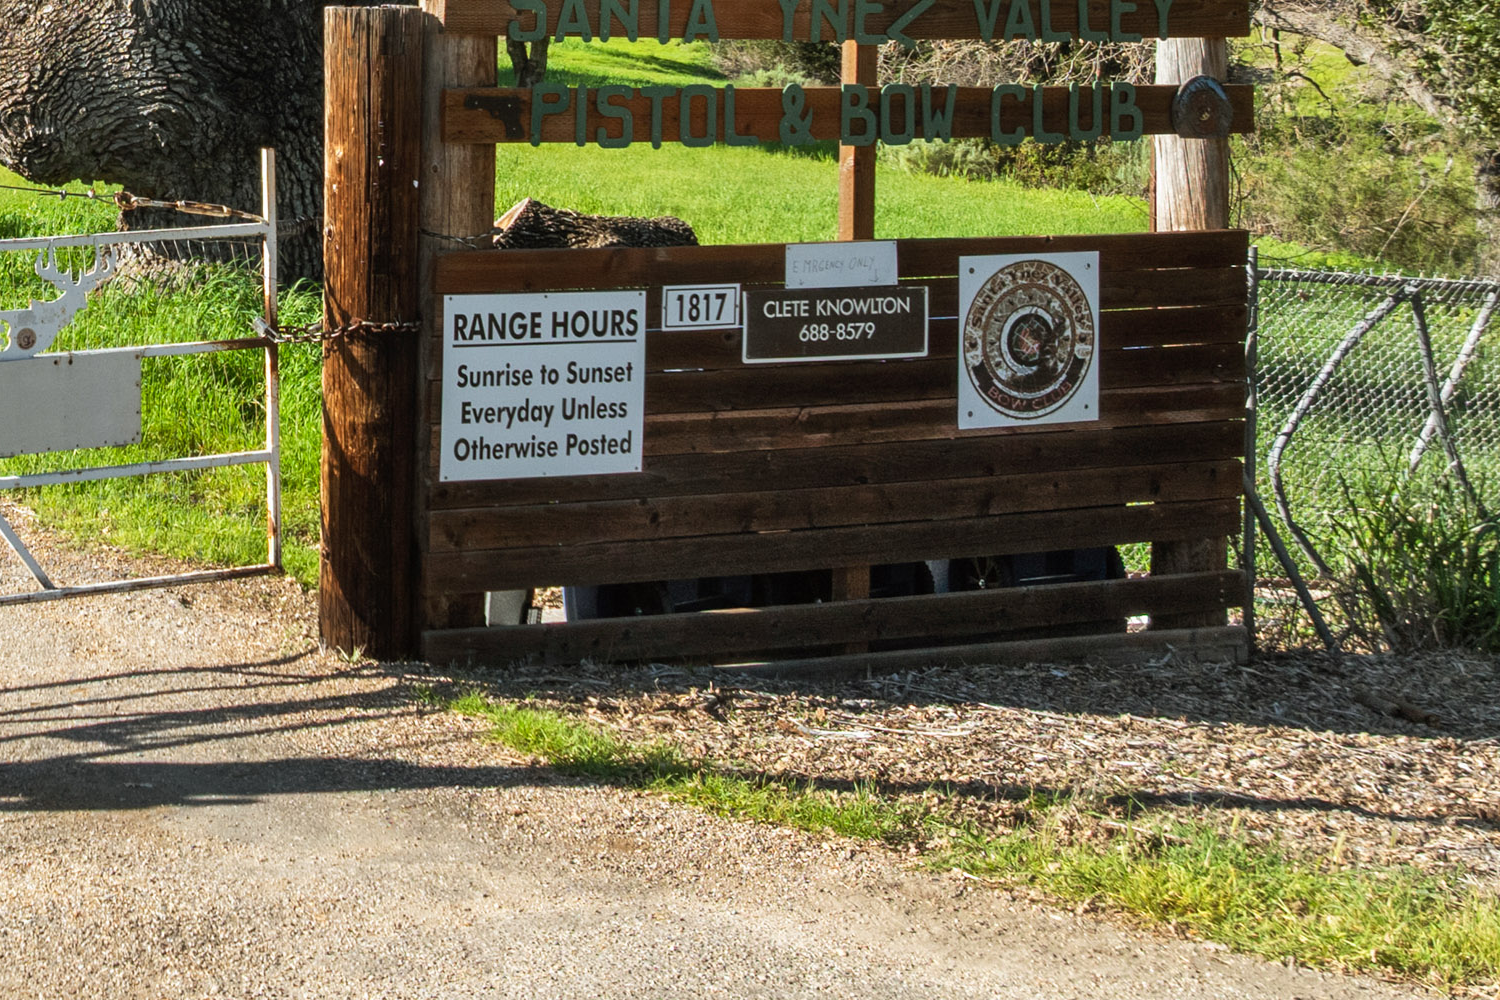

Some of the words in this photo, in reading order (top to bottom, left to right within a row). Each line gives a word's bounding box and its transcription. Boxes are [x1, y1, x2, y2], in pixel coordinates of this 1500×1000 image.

[530, 82, 759, 149] PISTOL
[779, 82, 816, 147] &
[841, 83, 957, 146] BOW
[991, 80, 1143, 146] CLUB
[676, 293, 727, 322] 1817
[763, 300, 809, 318] CLETE
[816, 297, 910, 316] KNOWLTON
[453, 312, 542, 341] RANGE
[551, 309, 638, 338] HOURS
[799, 322, 875, 342] 688-8579
[457, 362, 533, 388] Sunrise
[540, 364, 559, 385] to
[566, 361, 633, 384] Sunset
[988, 386, 1026, 410] BOW
[1032, 380, 1072, 409] CLUB
[461, 398, 554, 429] Everyday
[561, 395, 628, 420] Unless
[453, 434, 558, 461] Otherwise
[566, 430, 632, 456] Posted
